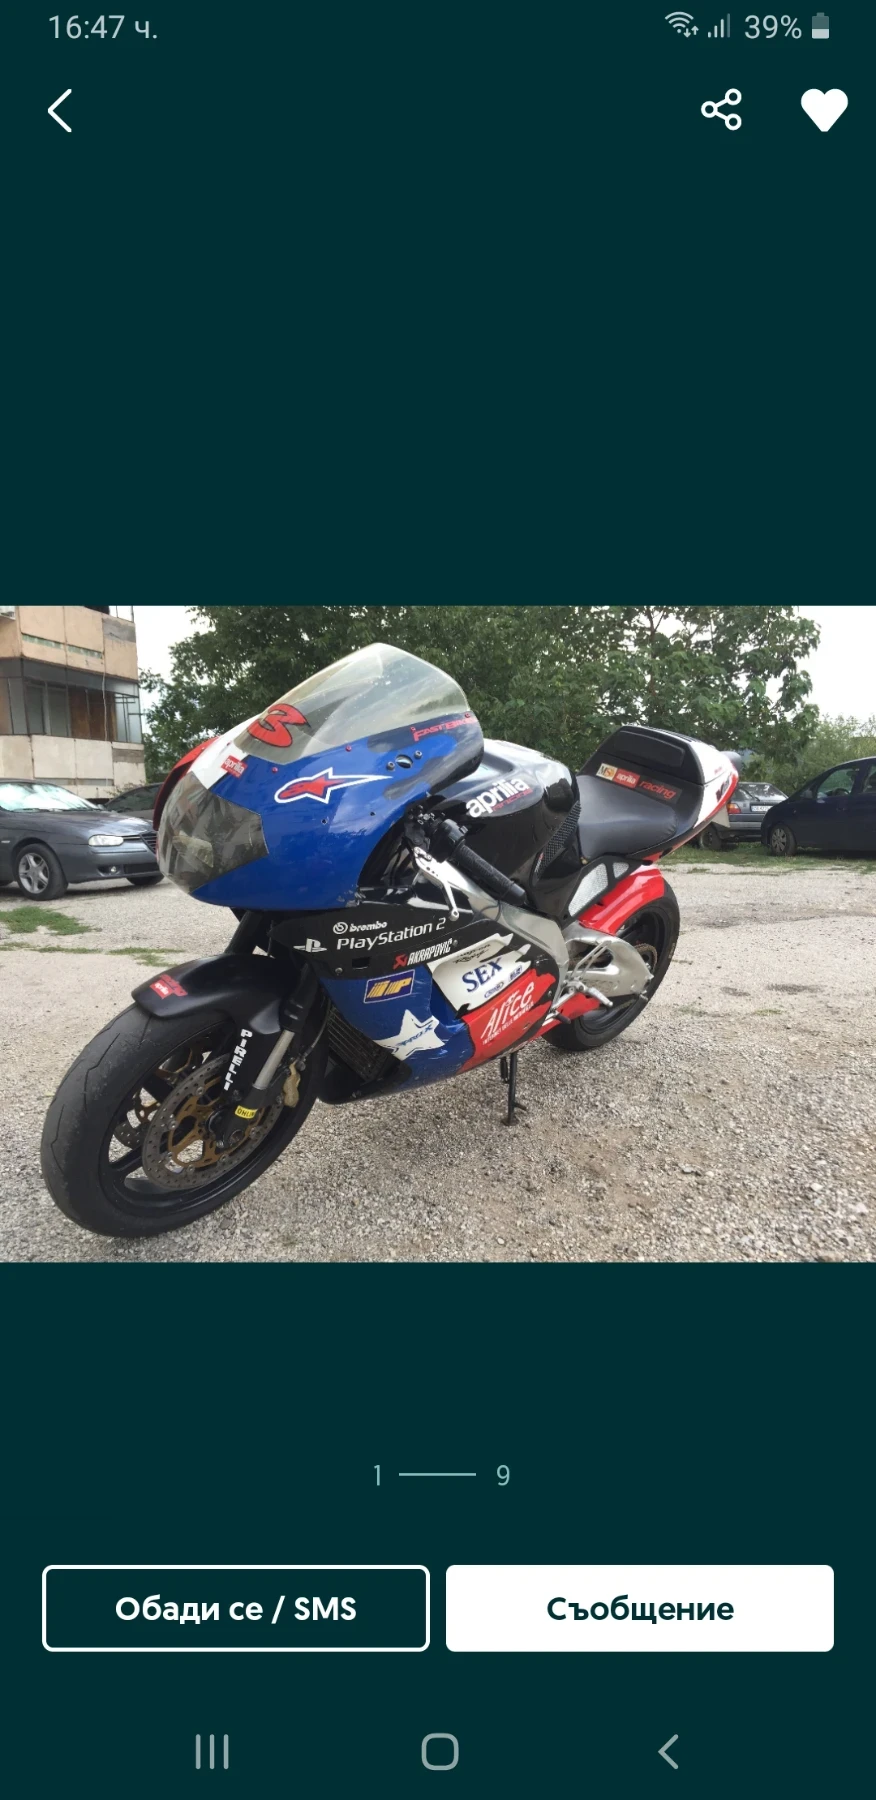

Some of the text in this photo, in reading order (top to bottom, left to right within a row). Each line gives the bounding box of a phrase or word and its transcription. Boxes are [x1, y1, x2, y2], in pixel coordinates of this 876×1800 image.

[247, 703, 309, 748] 3
[466, 779, 531, 818] aprilia
[616, 772, 637, 784] aprilia
[639, 780, 676, 799] racing
[336, 917, 446, 951] PlayStation 2
[350, 920, 388, 933] brembo
[461, 957, 502, 993] SEX
[480, 981, 535, 1040] Alice
[223, 1028, 253, 1091] PIRELLI
